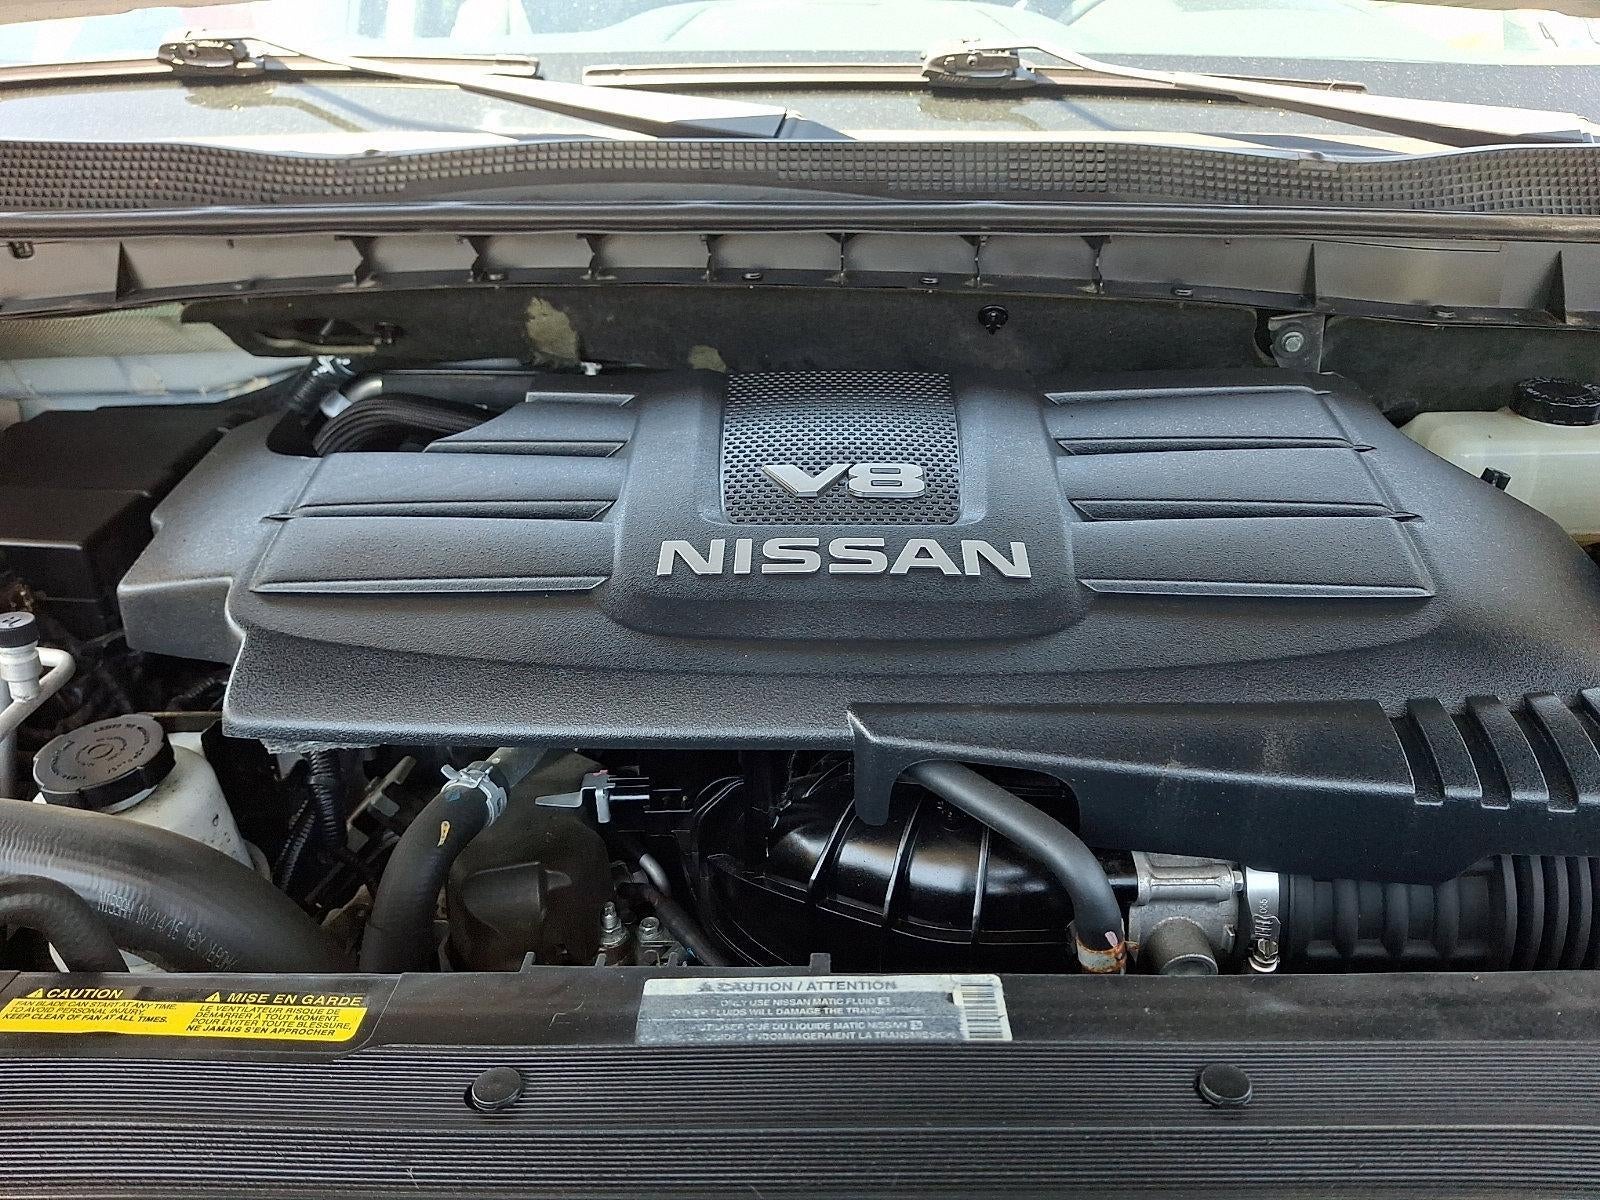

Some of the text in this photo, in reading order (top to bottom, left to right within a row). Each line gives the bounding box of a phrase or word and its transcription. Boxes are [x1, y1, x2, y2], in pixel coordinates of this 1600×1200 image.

[761, 463, 928, 499] V8
[656, 537, 1031, 578] NISSAN
[806, 980, 897, 991] ATTENTION
[46, 988, 124, 999] CAUTION
[227, 992, 363, 1006] MISE EN GARDE
[772, 998, 811, 1006] NISSAN
[844, 997, 876, 1005] FLUID
[216, 1006, 283, 1014] VENTILATEUR
[749, 1008, 773, 1016] WILL
[823, 1007, 844, 1015] THE
[265, 1013, 292, 1021] TOUT
[202, 1025, 242, 1033] JAMAIS
[270, 1028, 336, 1036] APPROCHER
